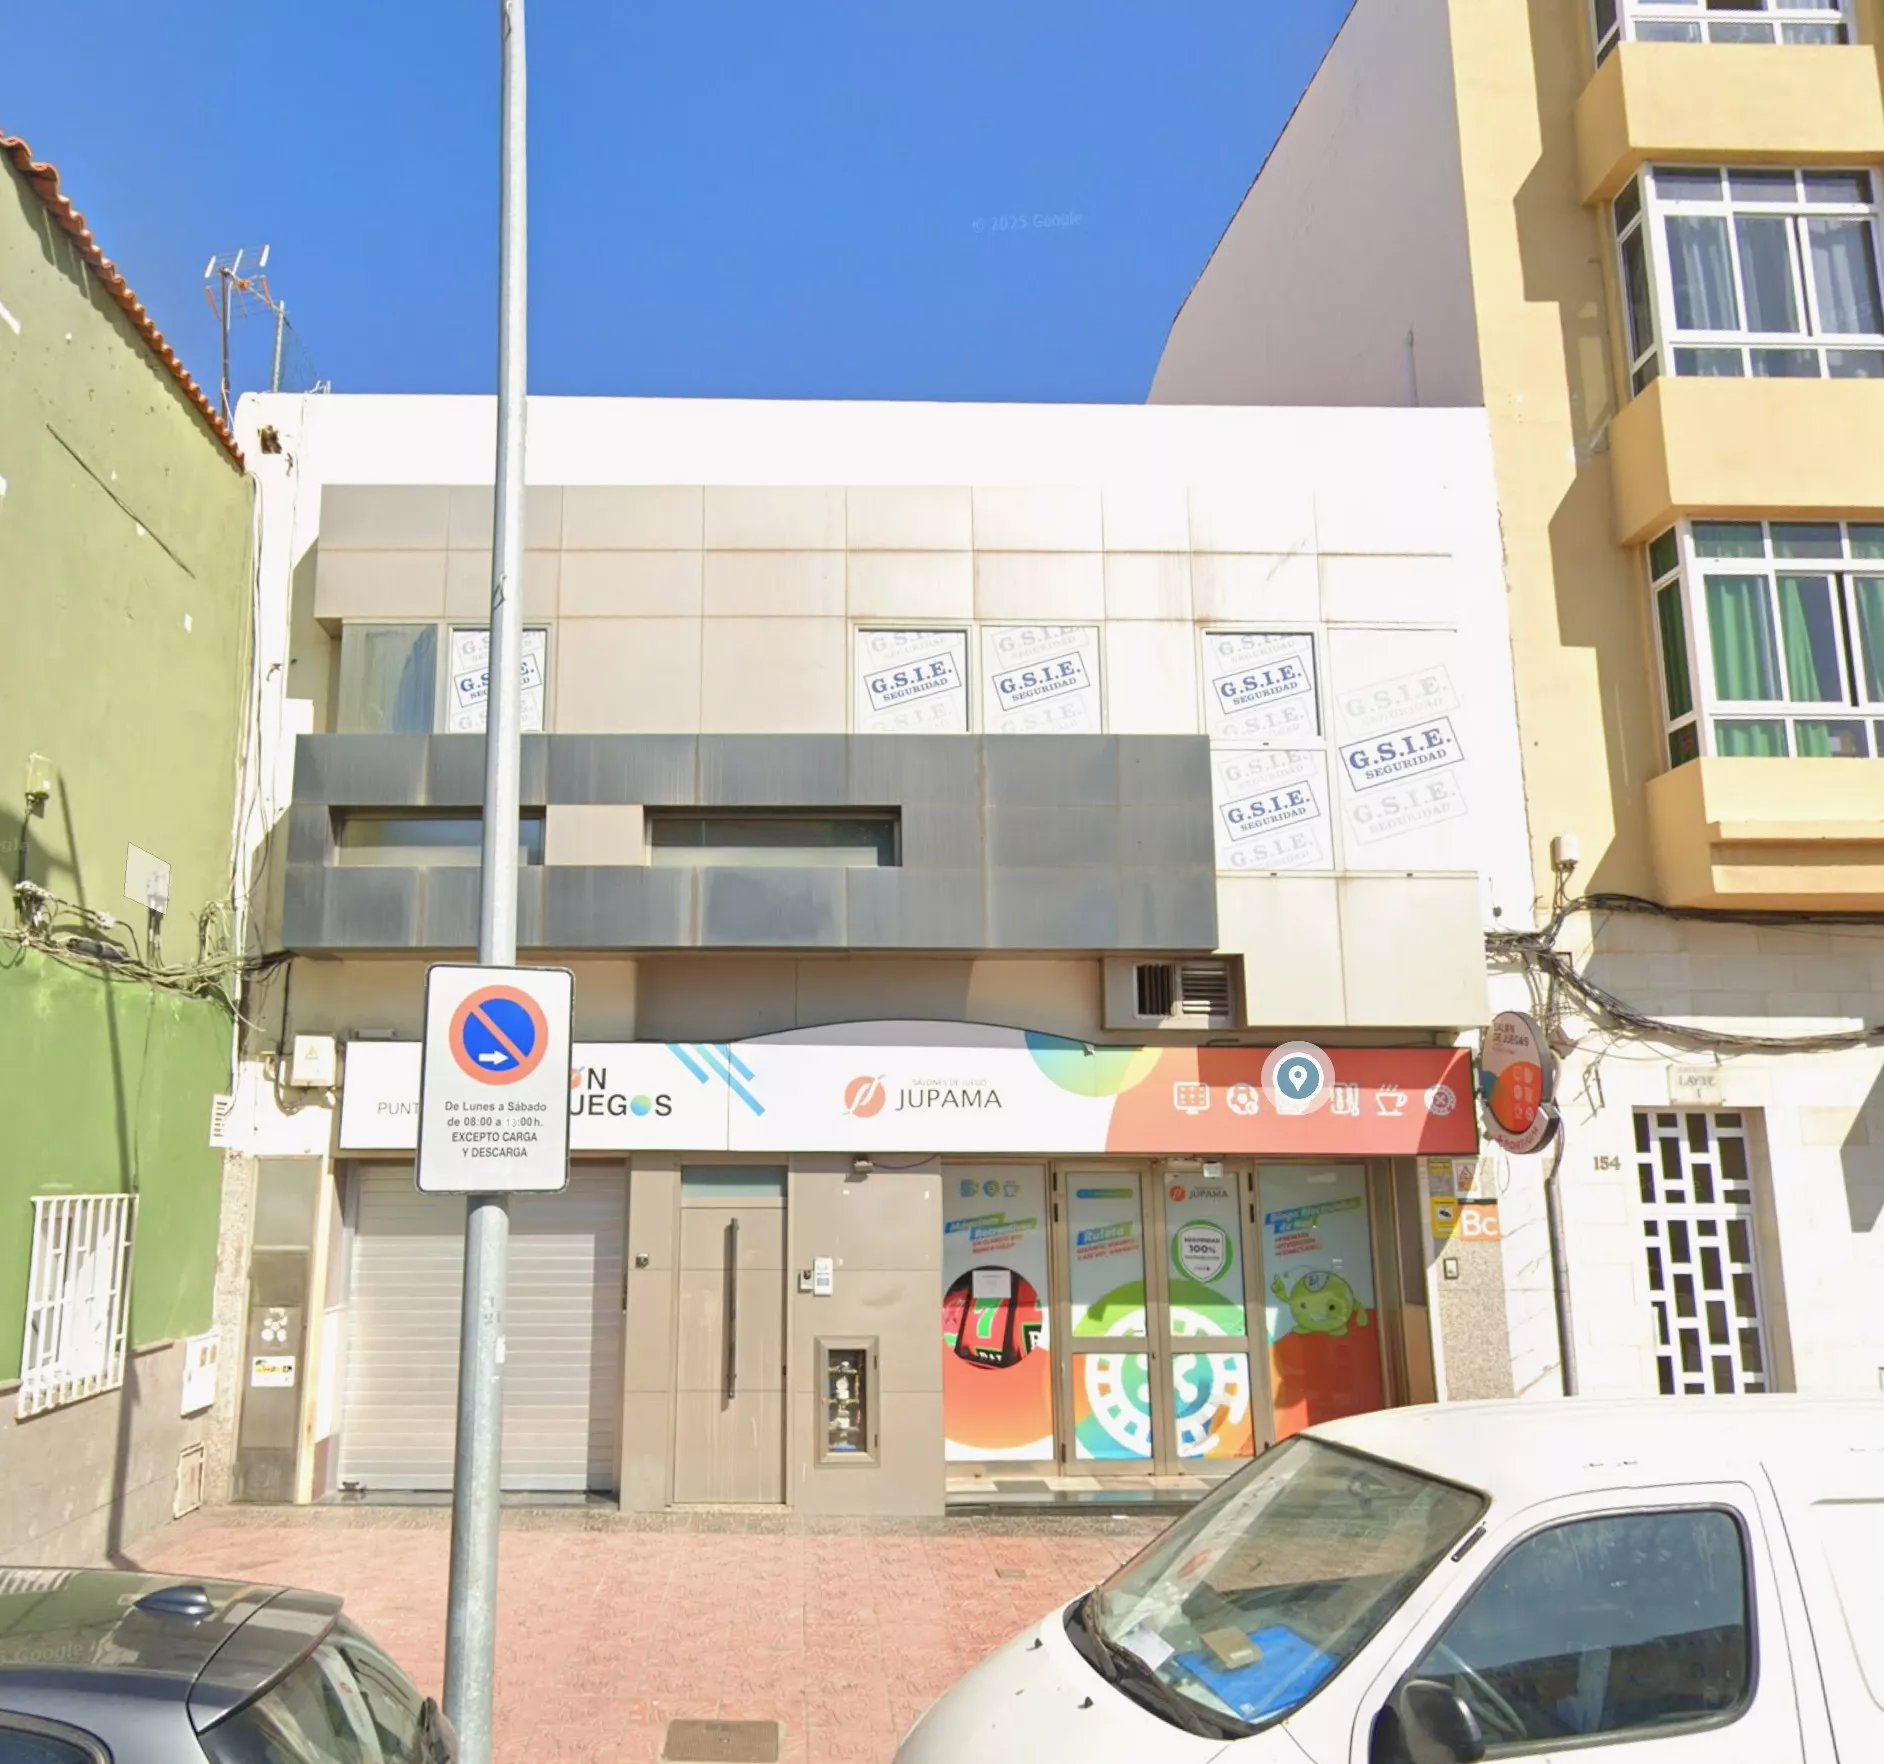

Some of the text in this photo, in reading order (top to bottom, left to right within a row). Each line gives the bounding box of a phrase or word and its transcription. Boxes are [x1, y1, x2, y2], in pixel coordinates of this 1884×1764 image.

[871, 660, 953, 694] G.S.I.E.
[883, 677, 948, 702] SEGURIDAD
[1000, 660, 1082, 694] G.S.I.E.
[1011, 677, 1077, 702] SEGURIDAD
[1220, 664, 1302, 698] G.S.I.E.
[1232, 681, 1298, 706] SEGURIDAD
[1346, 675, 1447, 717] G.S.I.E.
[1349, 727, 1453, 770] G.S.I.E.
[1364, 748, 1448, 780] SEGURIDAD
[1227, 789, 1311, 824] G.S.I.E.
[1353, 780, 1457, 824] G.S.I.E.
[1240, 807, 1307, 832] SEGURIDAD
[378, 1102, 420, 1115] PUNT
[445, 1101, 547, 1112] De Lunes a Sábado
[895, 1088, 1002, 1111] JUPAMA
[447, 1117, 461, 1126] de
[463, 1117, 493, 1127] 08:00
[495, 1118, 502, 1126] a
[451, 1132, 538, 1142] EXCEPTO CARGA
[462, 1147, 528, 1157] Y DESCARGA
[1593, 1156, 1621, 1171] 154
[1188, 1190, 1229, 1200] JUPAMA
[1461, 1209, 1499, 1236] Bc
[1188, 1245, 1216, 1254] 100%
